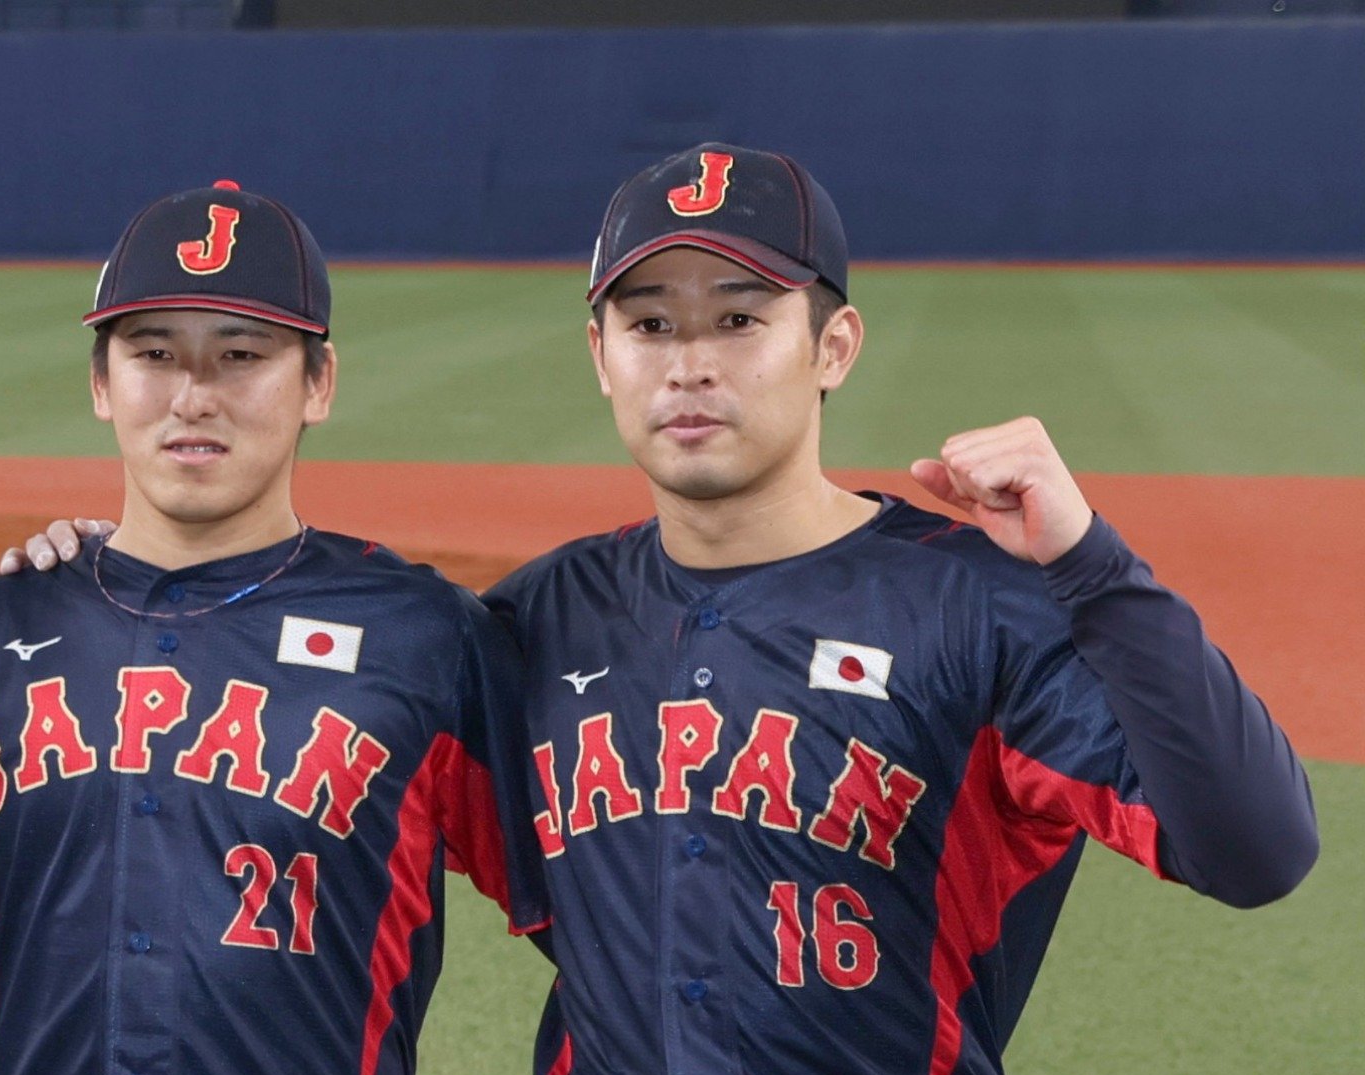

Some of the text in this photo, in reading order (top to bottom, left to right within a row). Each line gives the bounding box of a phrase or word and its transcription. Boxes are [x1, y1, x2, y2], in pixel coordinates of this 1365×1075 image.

[668, 152, 735, 217] J
[176, 204, 240, 275] J
[220, 843, 318, 955] 21
[767, 881, 881, 990] 16
